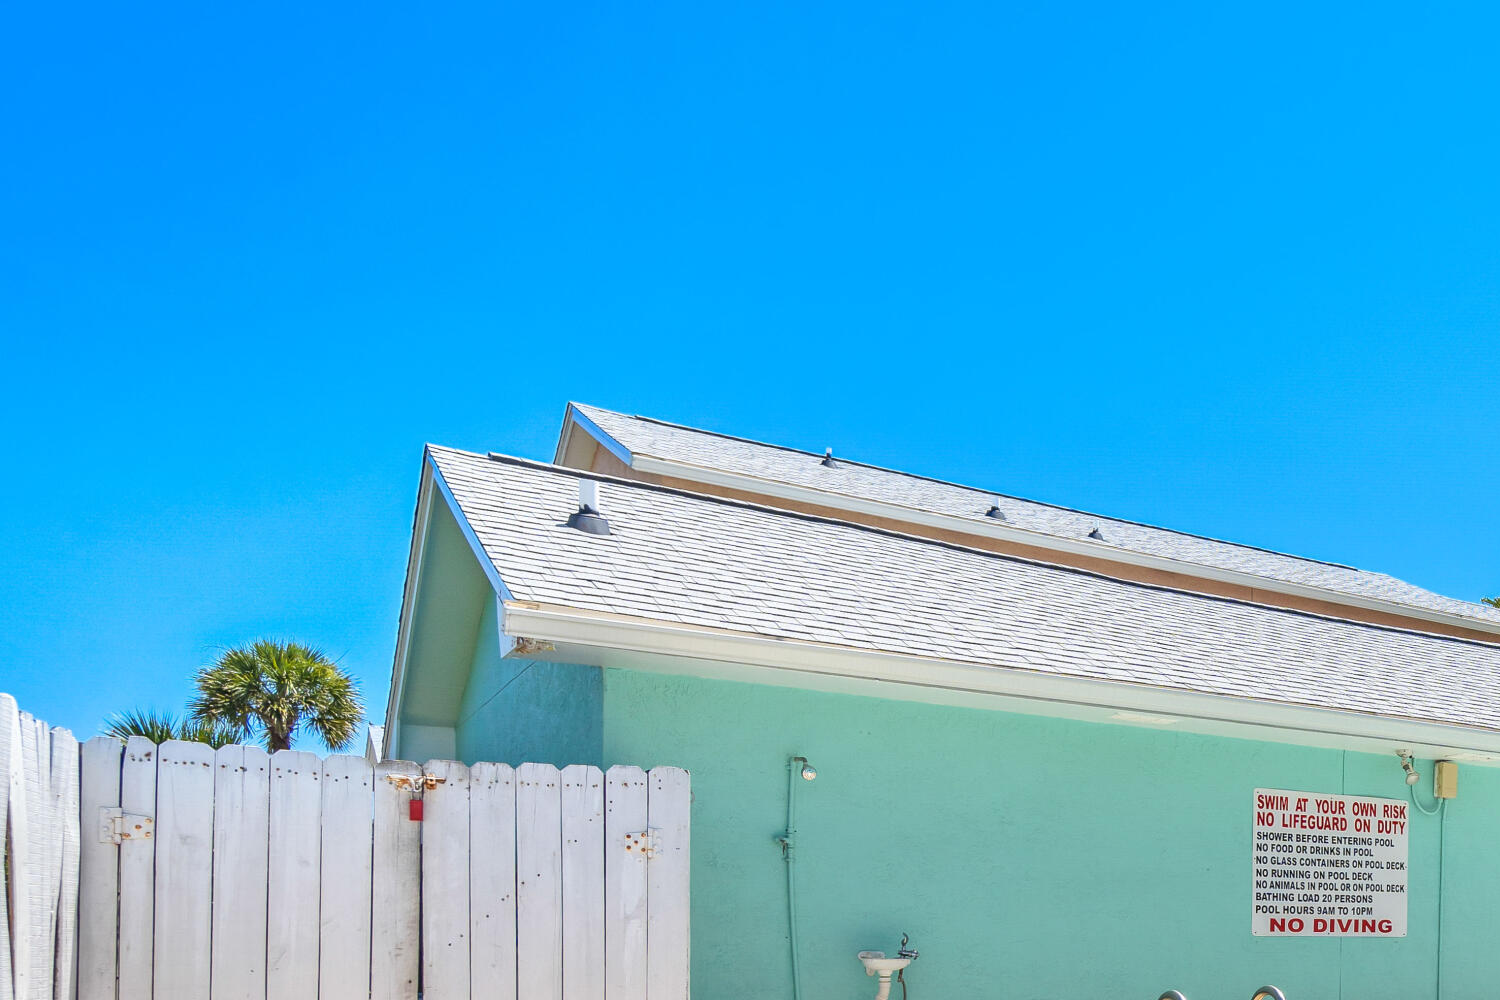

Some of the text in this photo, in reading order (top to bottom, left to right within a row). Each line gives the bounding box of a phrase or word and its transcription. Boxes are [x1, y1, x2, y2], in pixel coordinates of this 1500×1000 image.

[1257, 795, 1406, 819] SWIM AT YOUR OWN RISK
[1257, 812, 1405, 834] NO LIFEGUARD ON DUTY
[1257, 832, 1394, 847] SHOWER BEFORE ENTERING POOL
[1256, 843, 1373, 856] NO FOOD OR DRINKS IN POOL
[1256, 856, 1405, 870] NO GLASS CONTAINERS ON POOL DECK
[1256, 869, 1373, 881] NO RUNNING ON POOL DECK
[1256, 881, 1267, 889] NO
[1270, 881, 1305, 890] ANIMALS
[1318, 883, 1338, 891] POOL
[1353, 884, 1363, 892] ON
[1366, 884, 1384, 892] POOL
[1256, 893, 1373, 903] BATHING LOAD 20 PERSONS
[1256, 905, 1373, 915] POOL HOURS 9AM TO 10PM
[1270, 919, 1392, 933] NO DIVING
